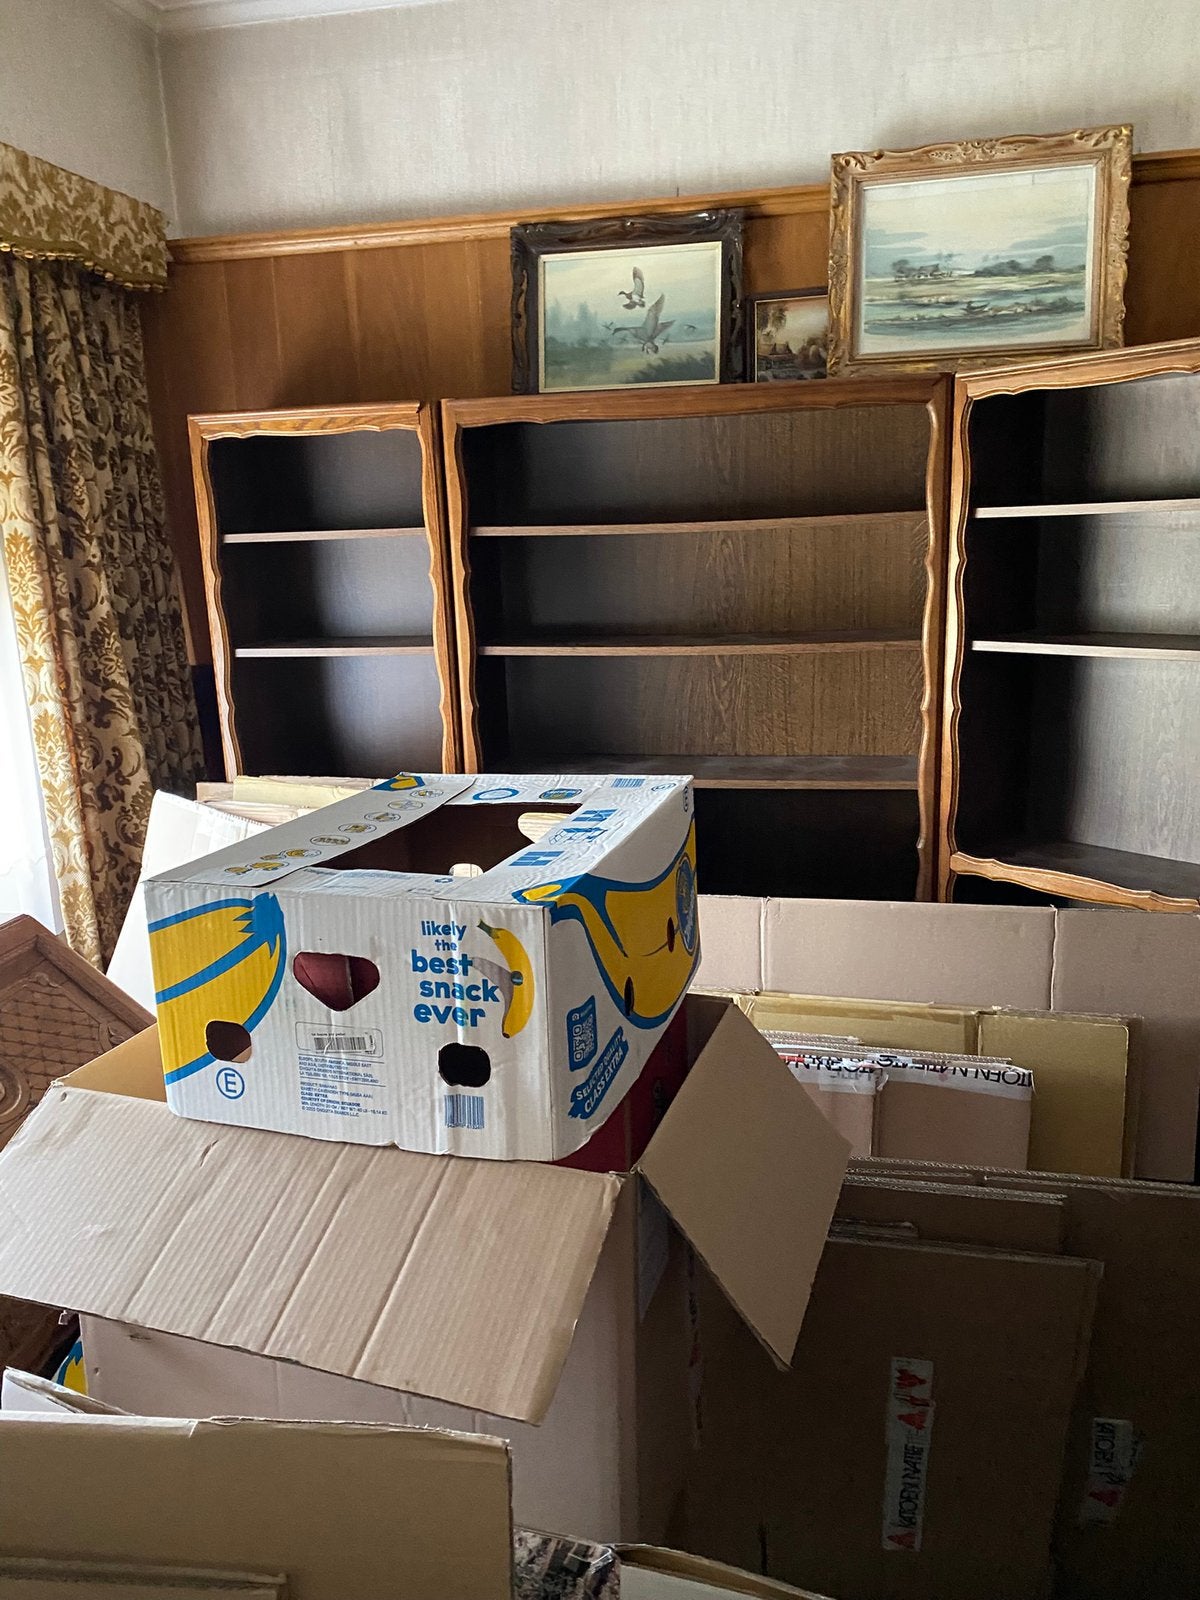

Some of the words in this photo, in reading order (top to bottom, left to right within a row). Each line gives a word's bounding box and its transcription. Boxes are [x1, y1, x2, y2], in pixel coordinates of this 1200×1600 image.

[421, 920, 467, 941] likely
[434, 939, 457, 951] the
[411, 949, 473, 976] best
[419, 978, 500, 1003] snack
[413, 1003, 486, 1028] ever
[223, 1072, 237, 1094] E
[584, 1077, 606, 1113] CLASS
[605, 1046, 624, 1082] EXTRA
